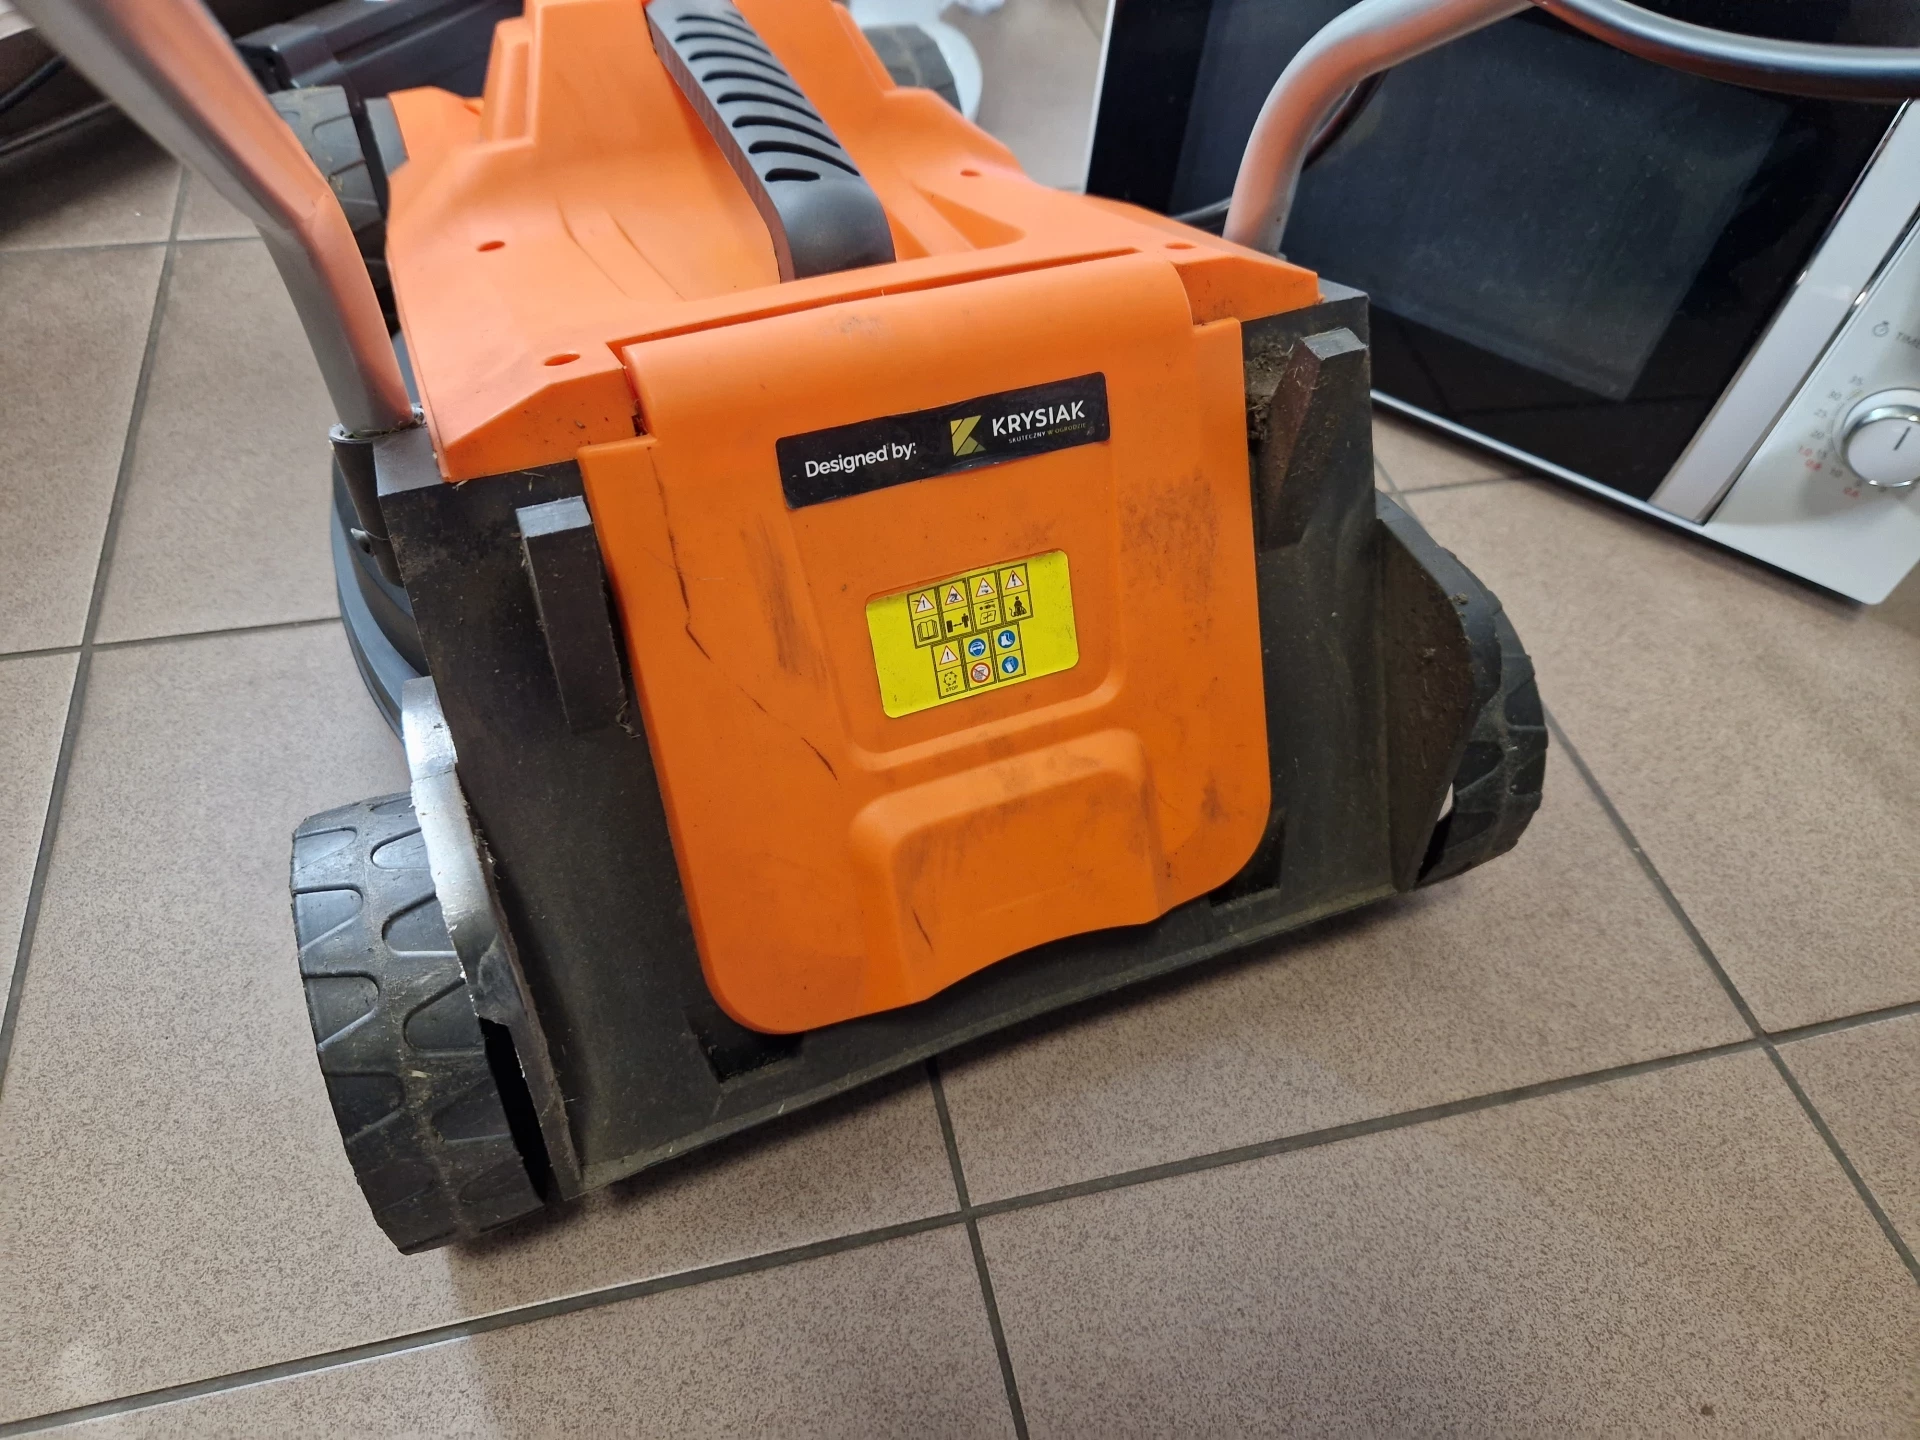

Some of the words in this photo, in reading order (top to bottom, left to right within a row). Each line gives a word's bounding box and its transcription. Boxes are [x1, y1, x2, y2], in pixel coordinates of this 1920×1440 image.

[992, 399, 1086, 437] KRYSIAK
[1008, 431, 1046, 444] SKUTECZNY
[1054, 422, 1087, 434] OGRODZIE
[804, 444, 889, 478] Designed
[891, 442, 917, 461] by:
[945, 684, 959, 693] STOP
